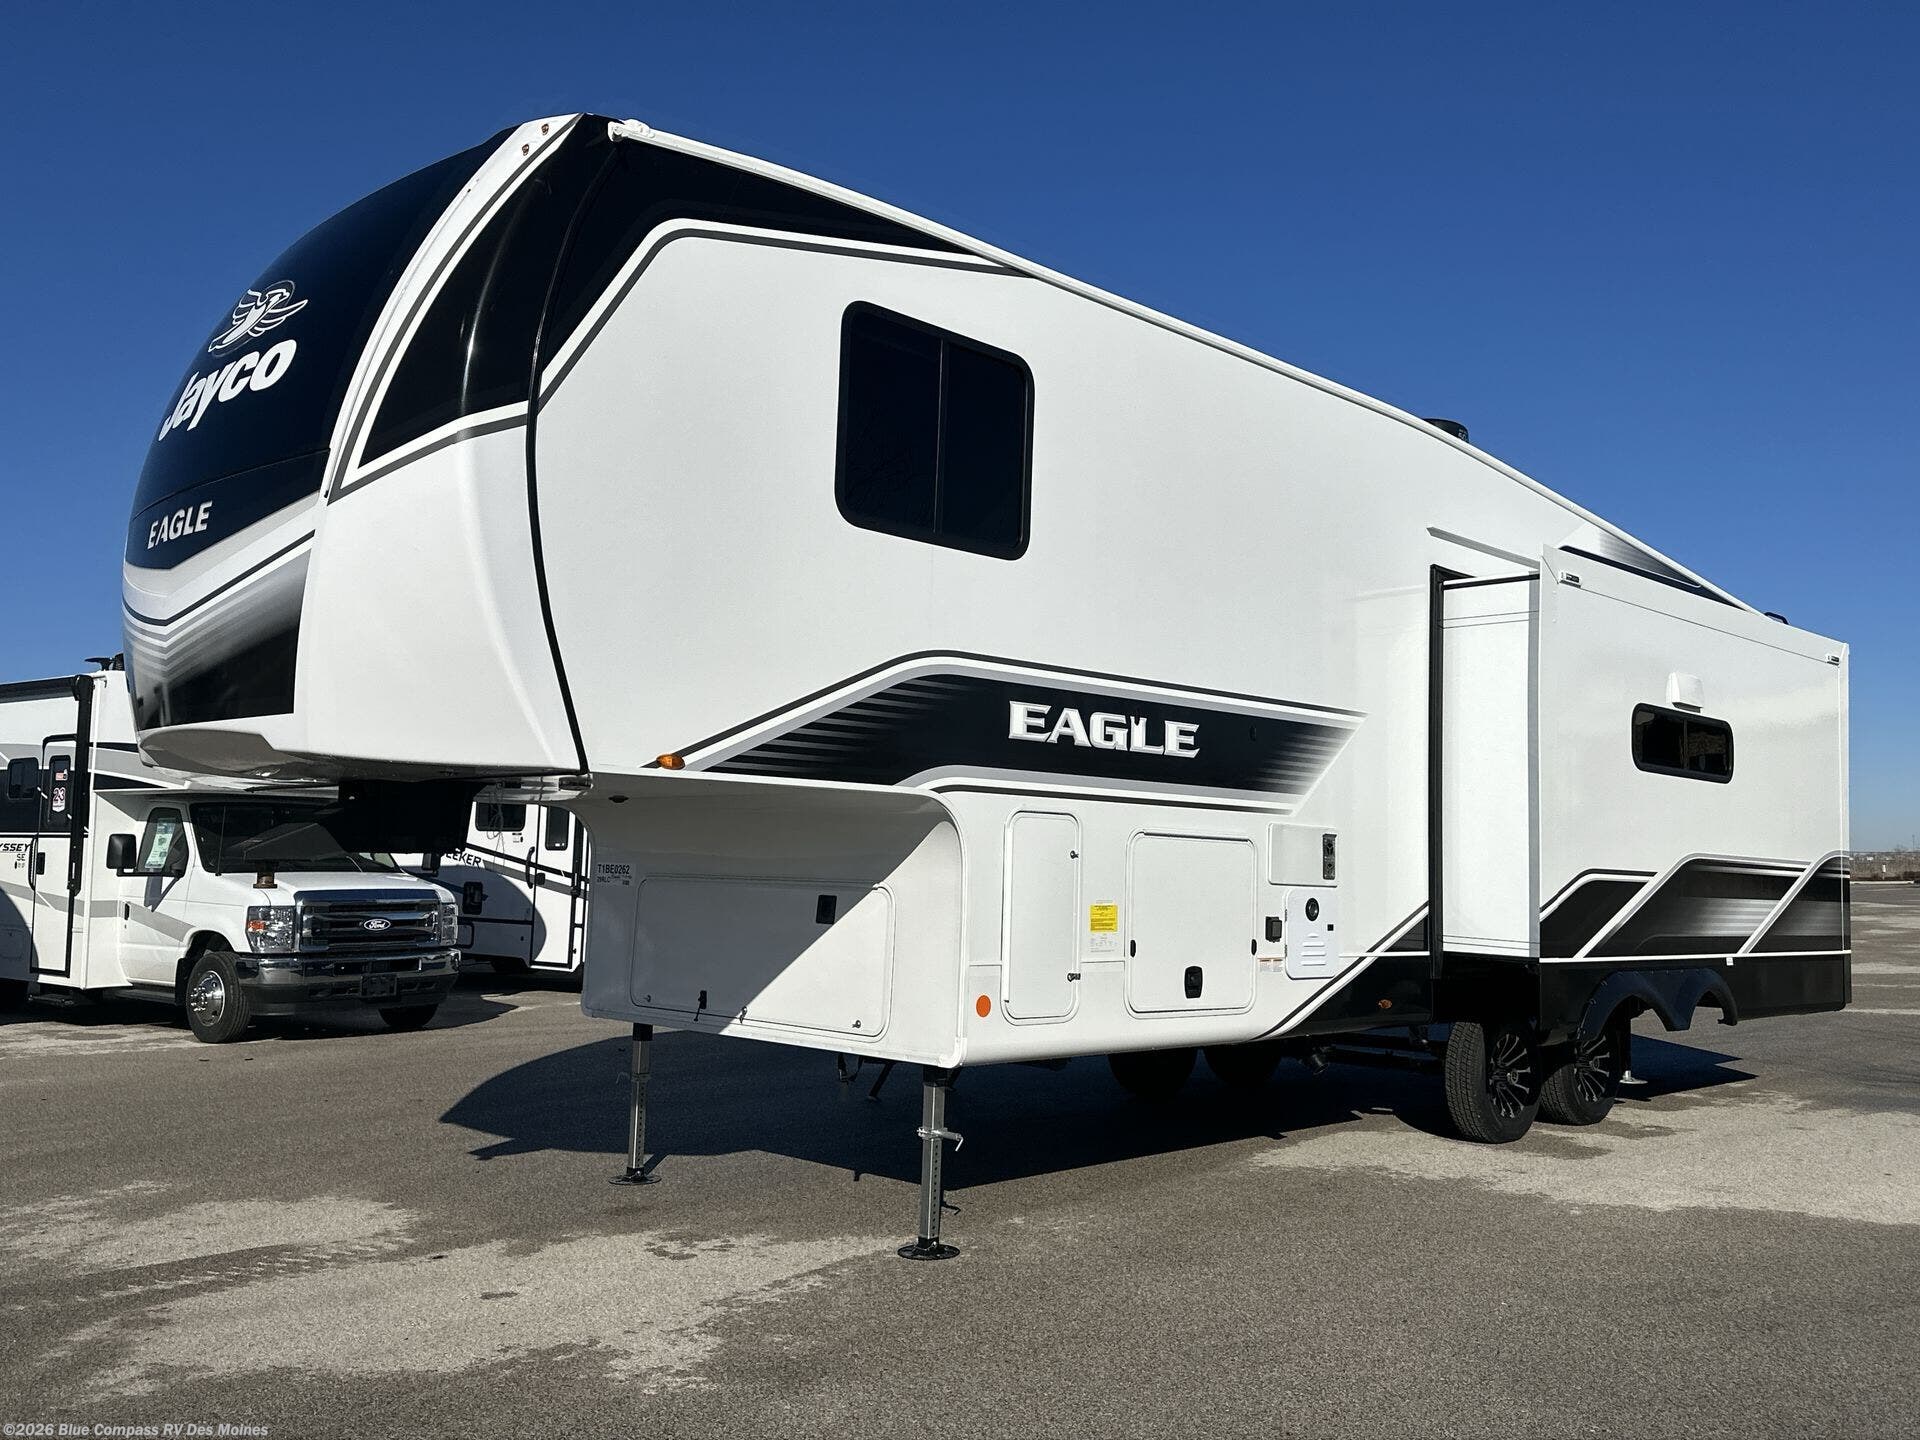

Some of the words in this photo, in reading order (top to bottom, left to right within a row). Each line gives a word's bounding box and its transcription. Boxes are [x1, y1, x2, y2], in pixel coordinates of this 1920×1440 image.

[158, 339, 297, 441] Jayco
[147, 500, 213, 549] EAGLE
[1008, 700, 1200, 759] EAGLE
